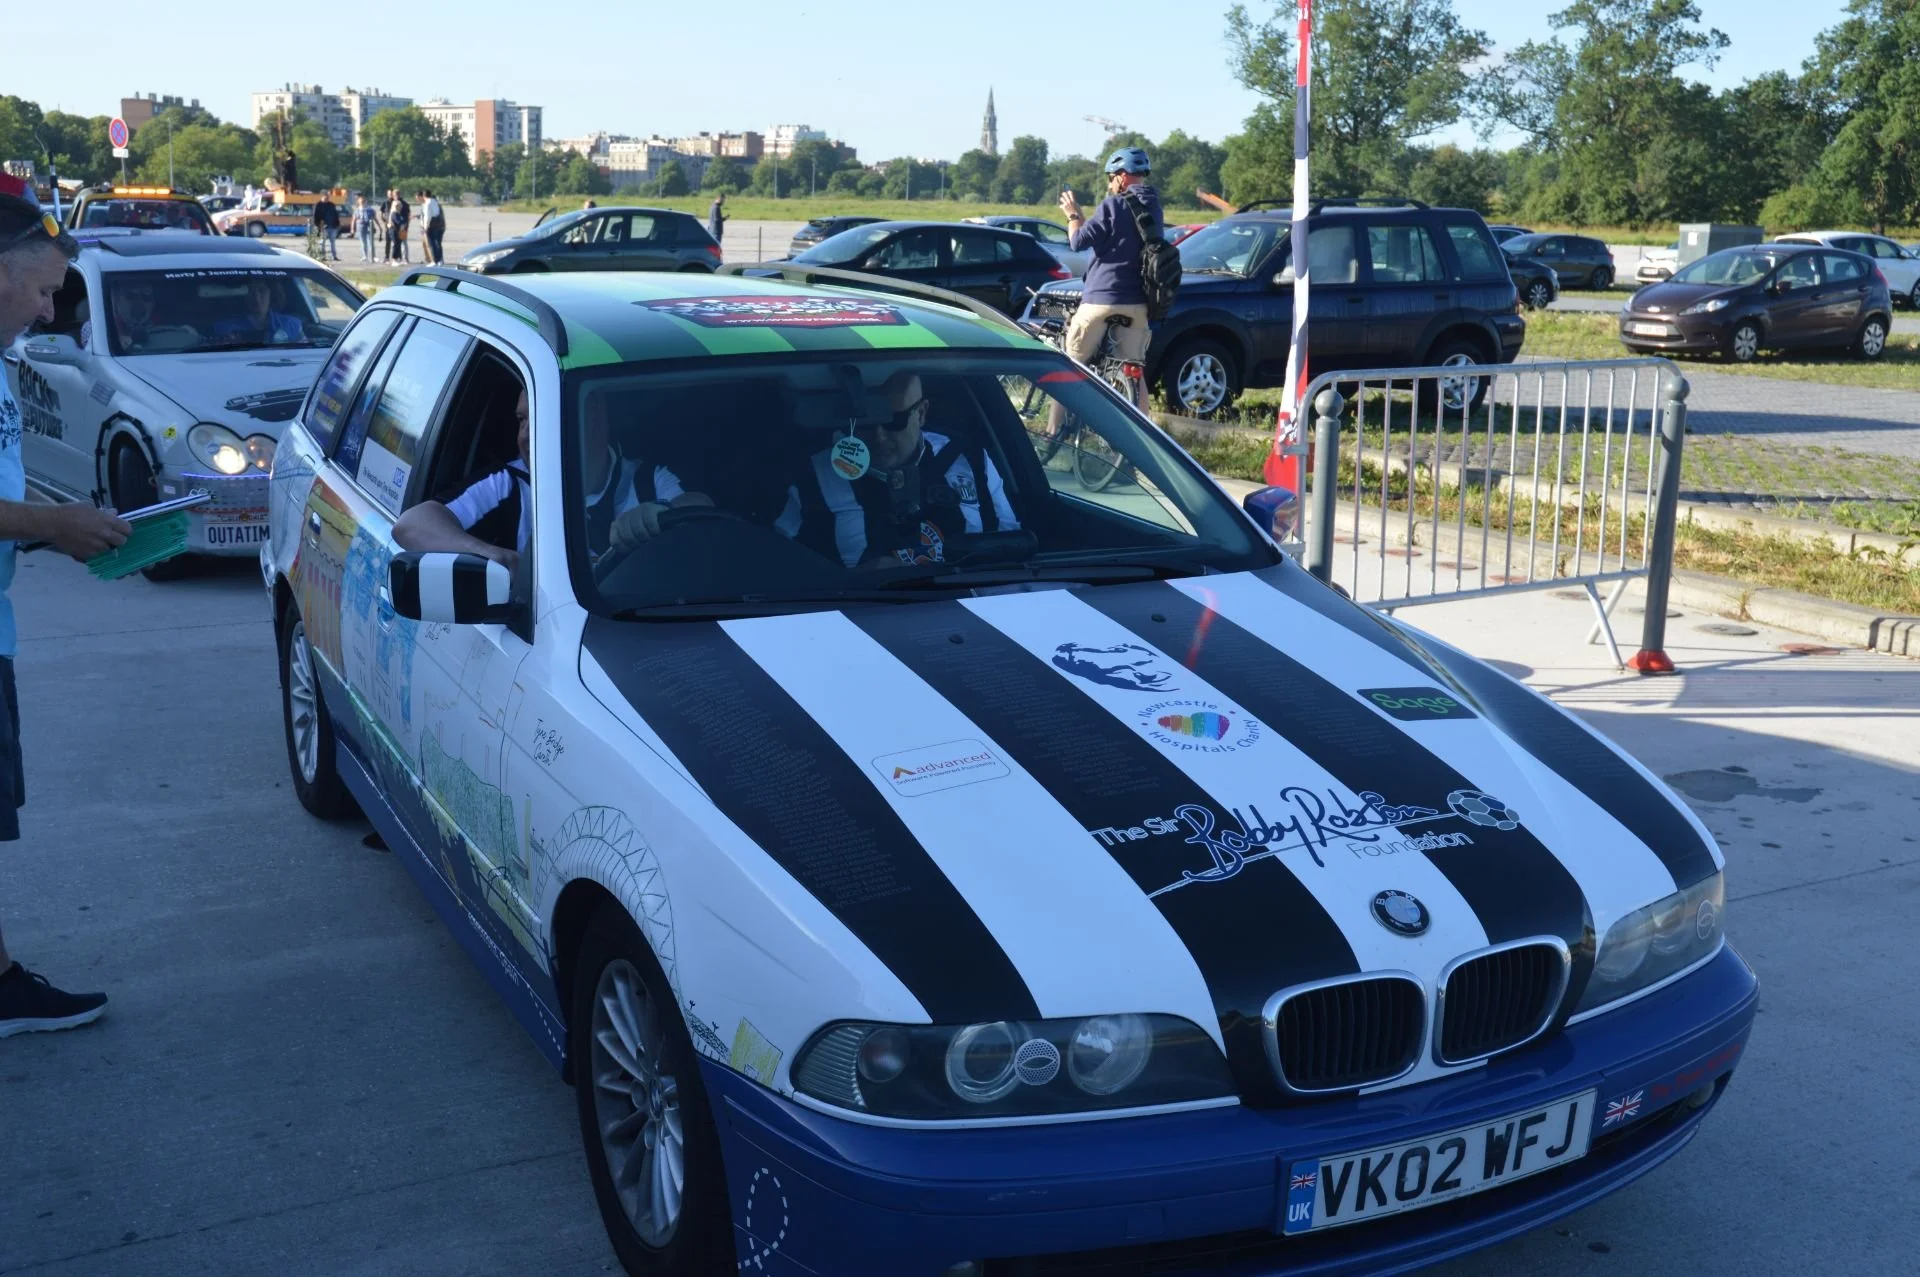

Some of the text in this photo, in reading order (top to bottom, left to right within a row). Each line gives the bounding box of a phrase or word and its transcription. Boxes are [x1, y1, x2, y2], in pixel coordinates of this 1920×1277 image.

[165, 271, 195, 279] Marty
[1137, 700, 1218, 718] Newcastle
[1371, 693, 1457, 713] Sage
[1148, 731, 1236, 753] Hospitals
[1236, 719, 1261, 748] Charity
[916, 752, 992, 774] advanced
[1088, 786, 1439, 882] The Sir Bobby Robson
[1345, 831, 1475, 860] Foundation
[1320, 1102, 1578, 1218] VK02 WFJ
[1288, 1201, 1311, 1223] UK
